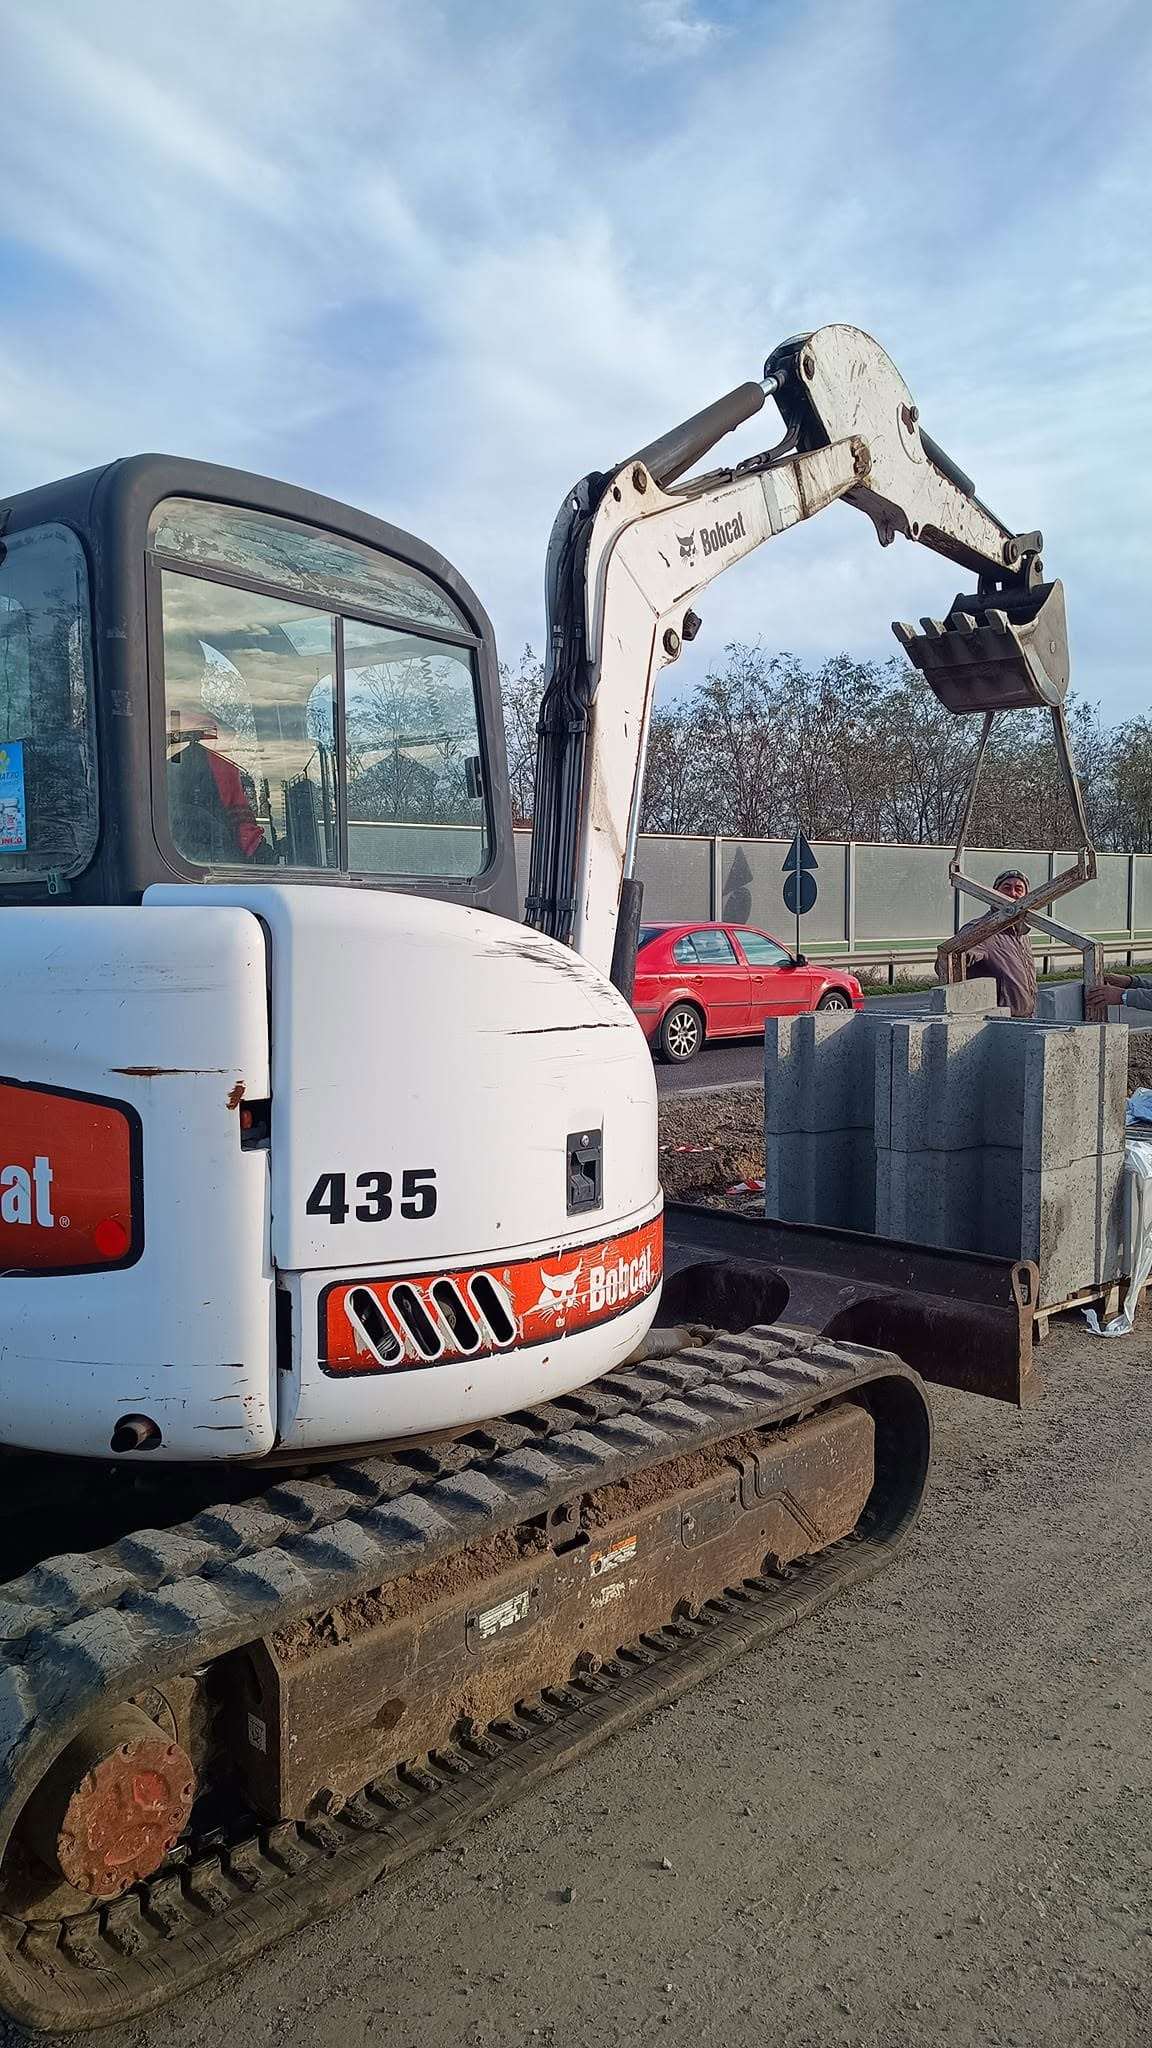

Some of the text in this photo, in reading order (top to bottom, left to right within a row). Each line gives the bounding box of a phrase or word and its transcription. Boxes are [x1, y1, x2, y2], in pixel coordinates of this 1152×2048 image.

[699, 511, 747, 556] Bobcat
[306, 1169, 437, 1224] 435
[590, 1244, 653, 1312] Bobcat
